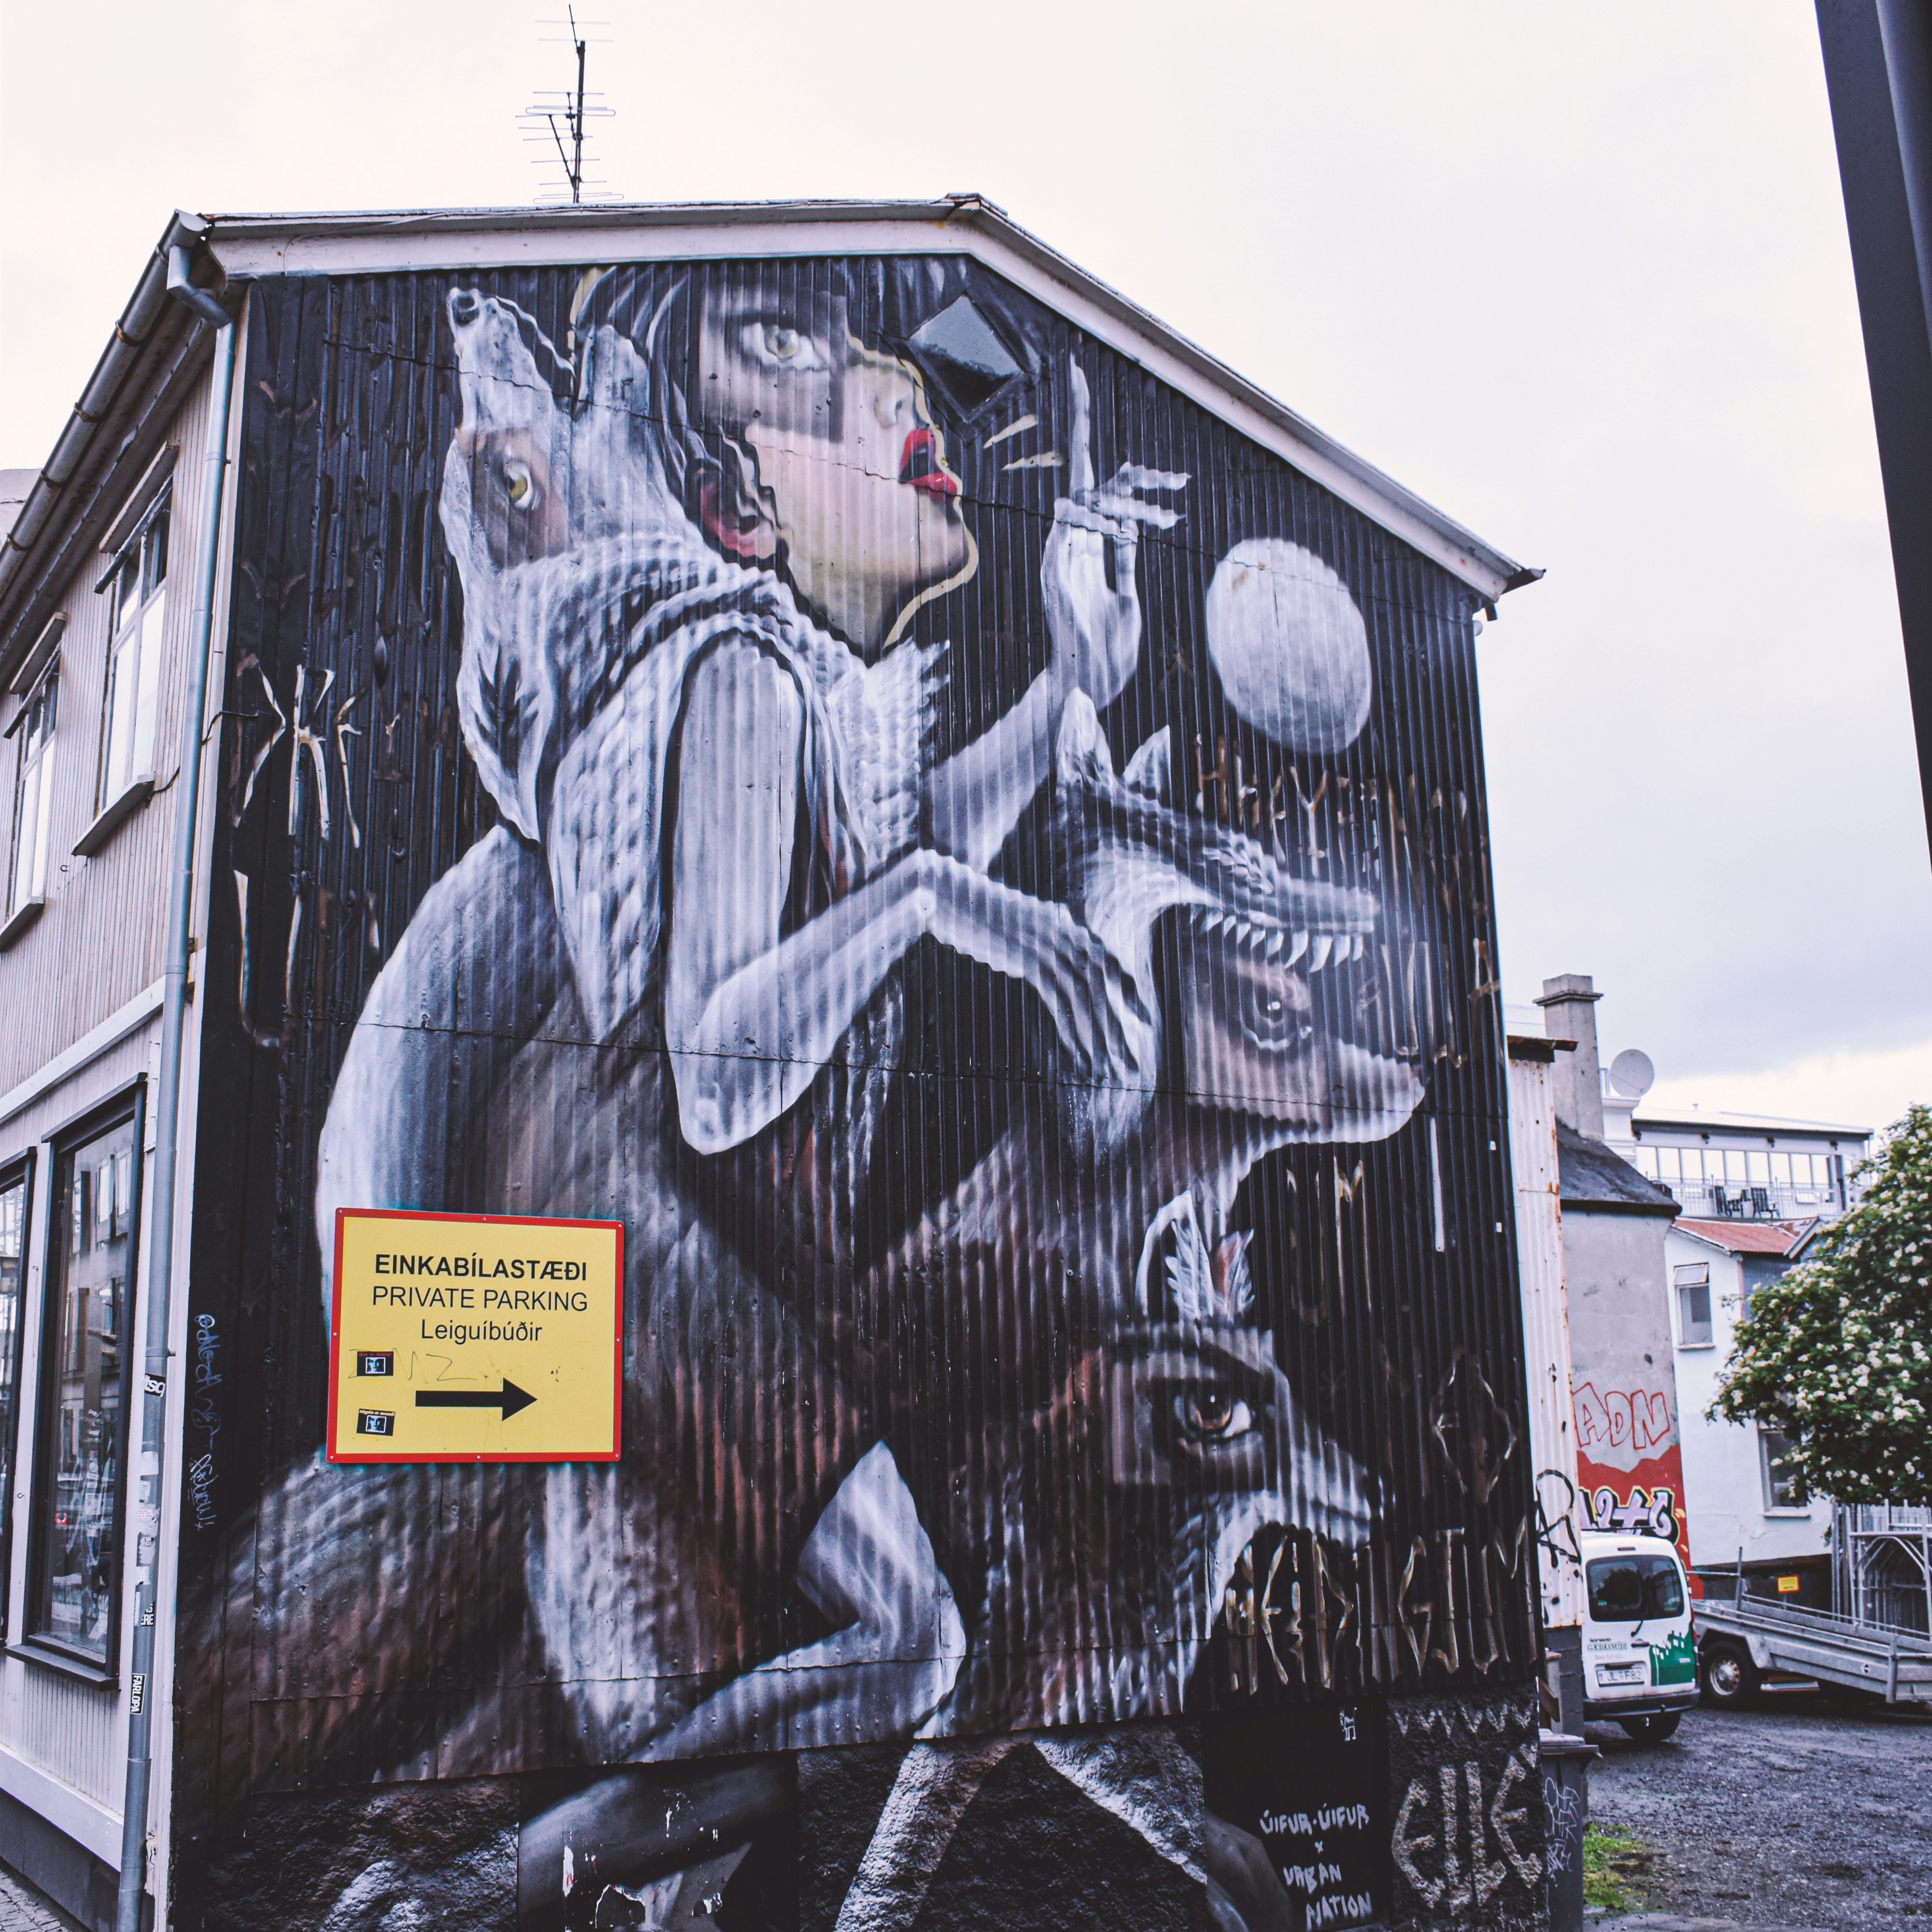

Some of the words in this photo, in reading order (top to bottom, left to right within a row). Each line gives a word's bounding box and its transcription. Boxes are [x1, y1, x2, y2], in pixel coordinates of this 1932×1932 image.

[374, 1252, 587, 1281] EINKABÍLASTÆÐI
[372, 1285, 475, 1308] PRIVATE
[483, 1289, 588, 1312] PARKING
[421, 1319, 543, 1345] Leiguíbúðir
[130, 1675, 143, 1713] FARLOPA
[1306, 1890, 1373, 1932] NATION
